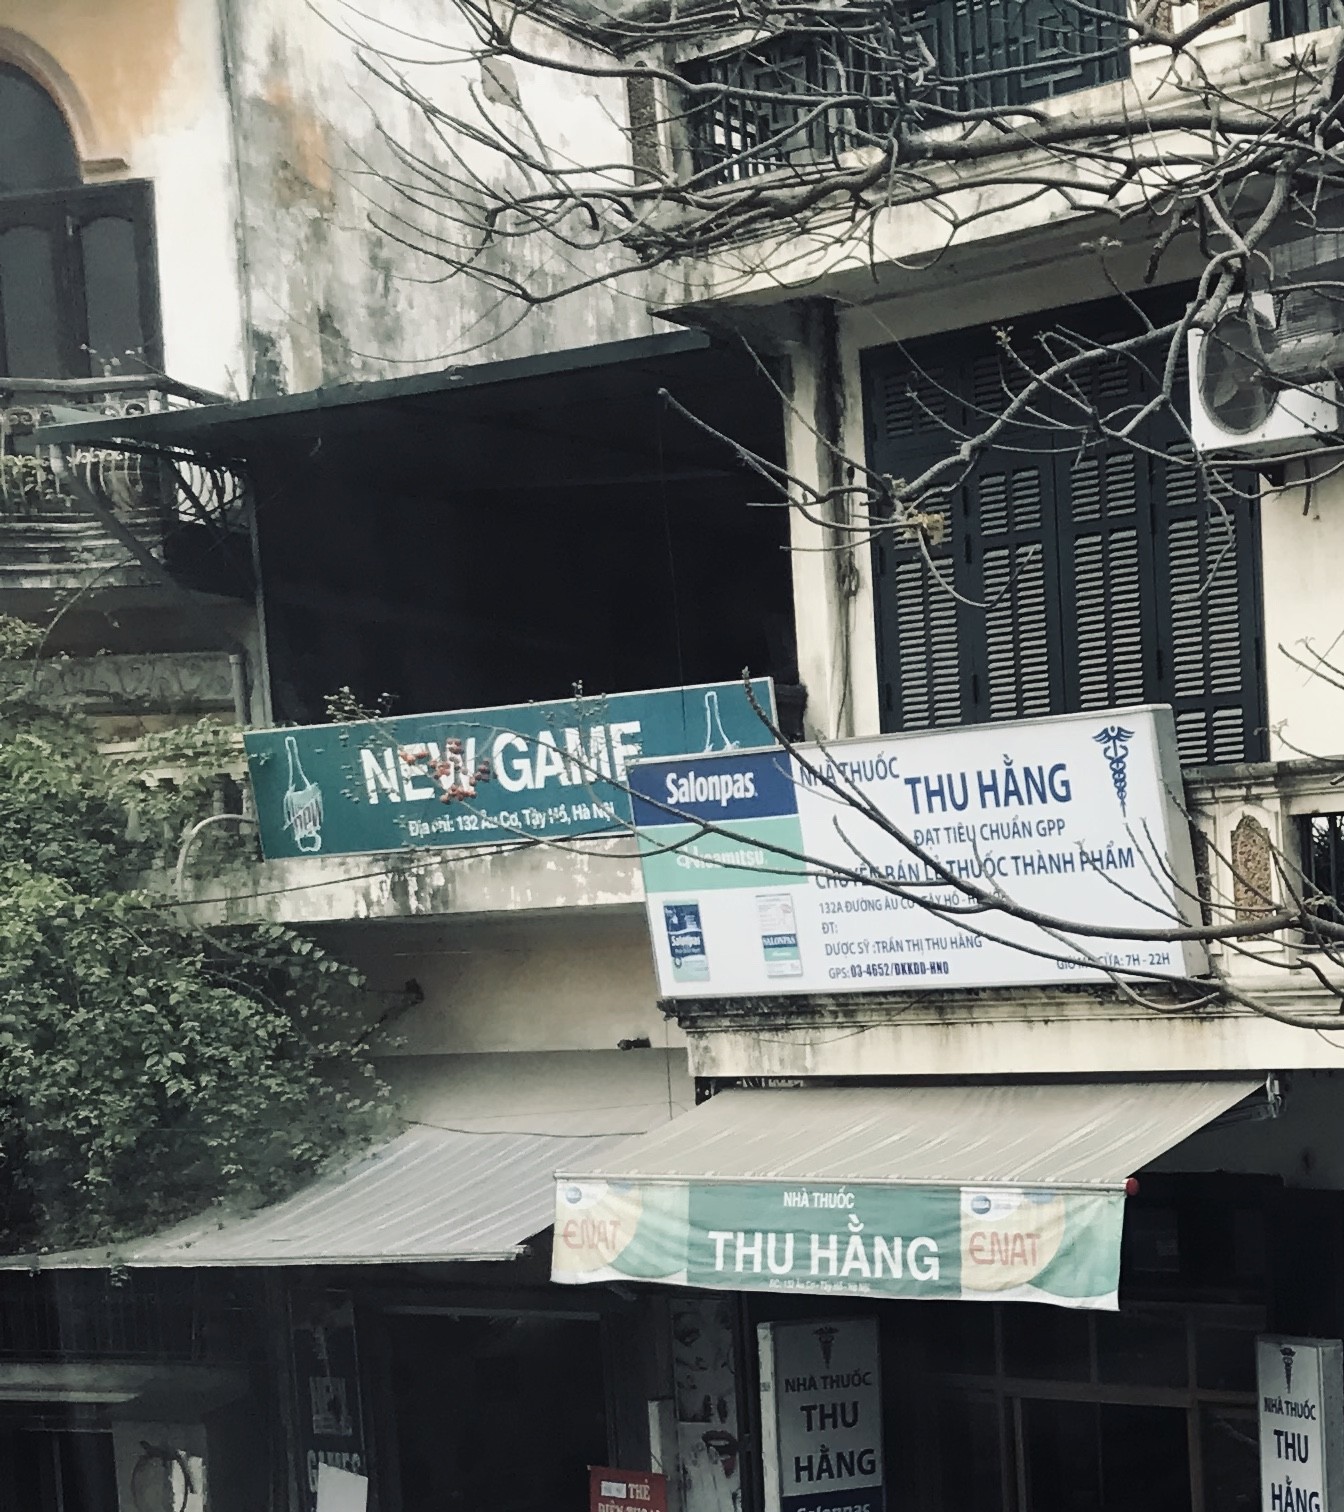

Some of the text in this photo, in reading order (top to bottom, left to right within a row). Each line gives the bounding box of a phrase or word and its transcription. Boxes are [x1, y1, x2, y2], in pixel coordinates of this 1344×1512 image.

[360, 720, 642, 805] NEW GAME
[839, 750, 900, 785] THUỐC
[665, 771, 757, 807] Salonpas
[904, 754, 1072, 815] THU HẰNG
[456, 814, 479, 832] 132
[571, 802, 590, 821] Hà
[914, 815, 1066, 851] ĐẠT TIÊU CHUẨN GPP
[886, 856, 921, 883] BÁN
[946, 849, 1008, 880] THUỐC
[1013, 849, 1075, 876] THÀNH
[1079, 844, 1136, 872] PHẨM
[819, 900, 844, 914] 132A
[885, 896, 899, 911] ÂU
[821, 921, 838, 935] ĐT:
[824, 942, 856, 959] DƯỢC
[925, 937, 948, 951] THU
[1126, 954, 1140, 966] 7H
[1148, 952, 1170, 965] 22H
[783, 1185, 855, 1209] NHÀ THUỐC
[708, 1214, 940, 1281] THU HẰNG
[968, 1231, 1041, 1266] ENAT
[785, 1368, 872, 1393] NHÀ THUỐC
[800, 1401, 859, 1432] THU
[1284, 1399, 1316, 1420] THUỐC
[794, 1443, 876, 1483] HẰNG
[1273, 1429, 1308, 1464] THU
